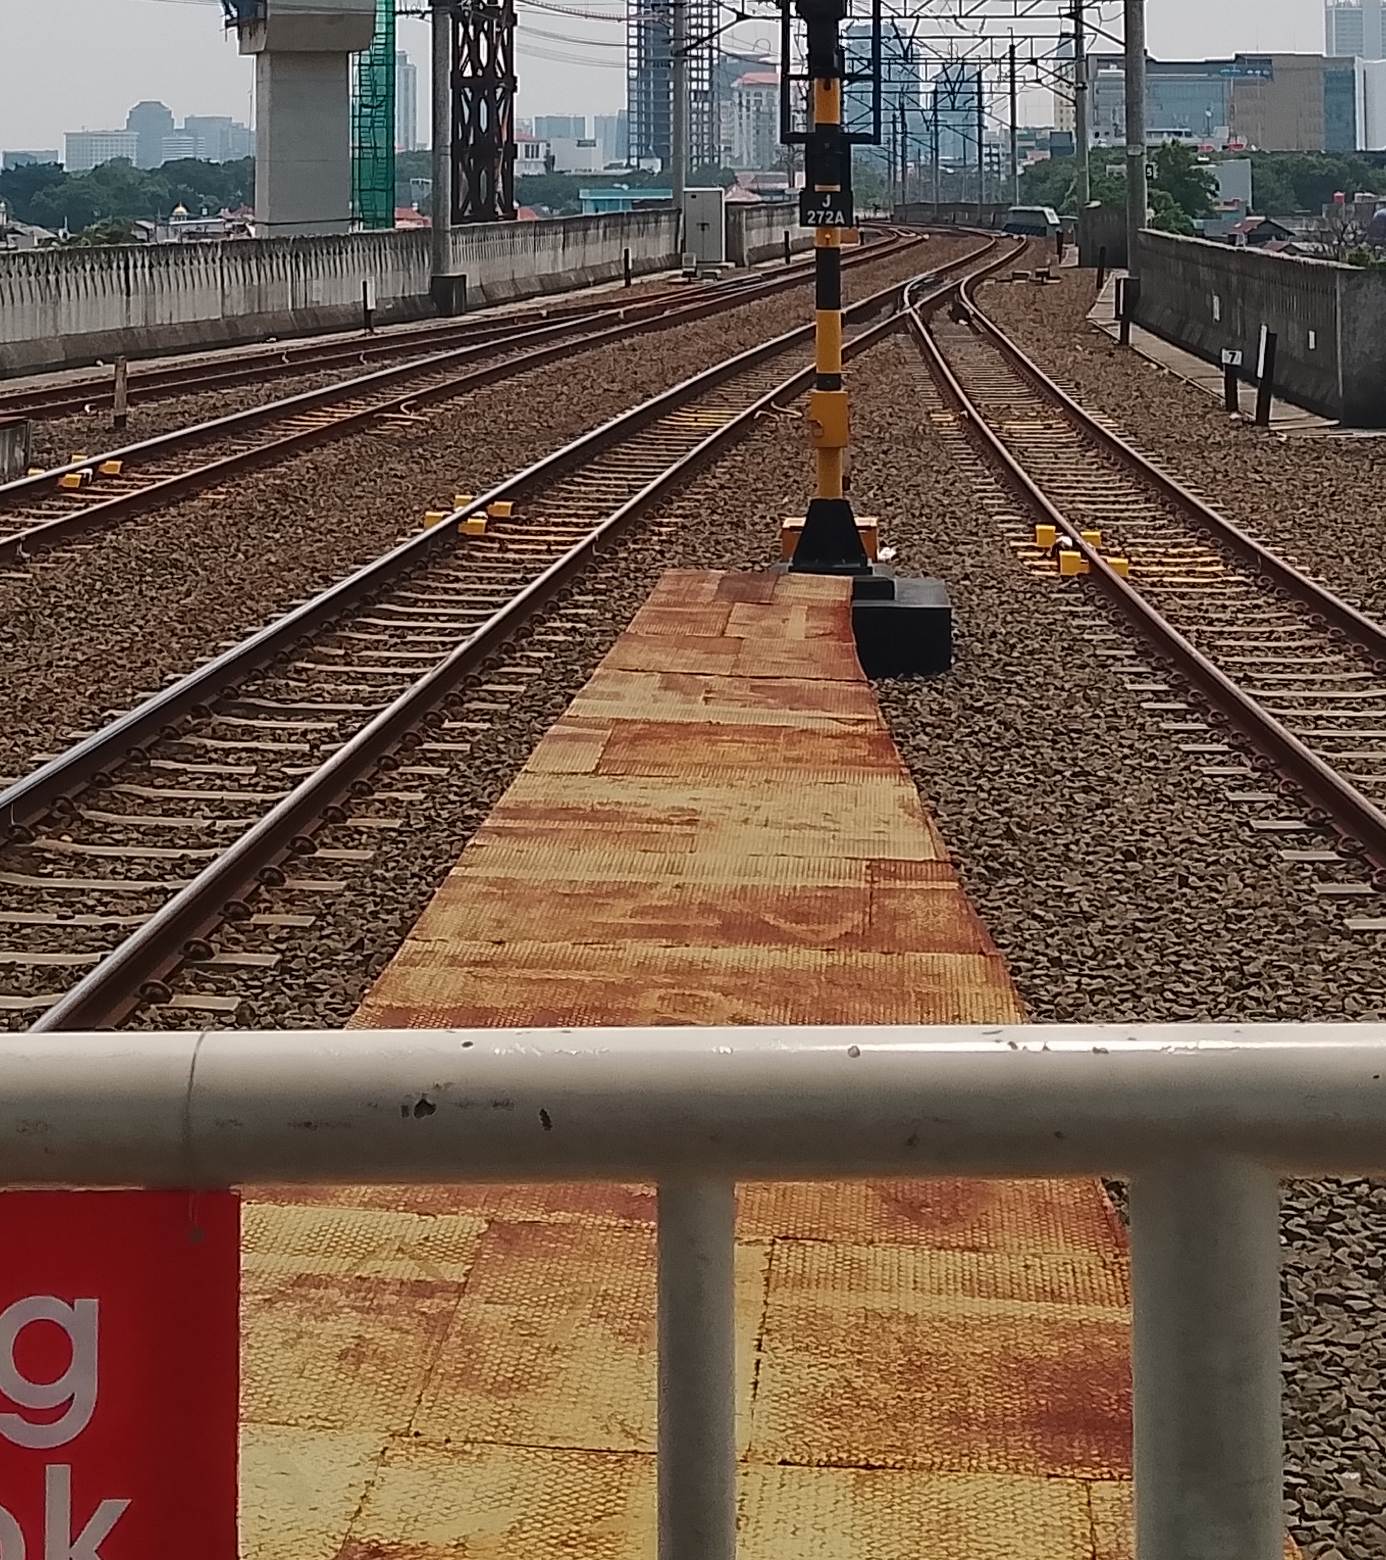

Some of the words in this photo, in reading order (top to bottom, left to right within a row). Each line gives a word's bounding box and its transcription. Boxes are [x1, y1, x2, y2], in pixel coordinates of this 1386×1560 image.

[822, 193, 831, 208] J
[807, 210, 845, 224] 272A
[1228, 351, 1237, 363] 7
